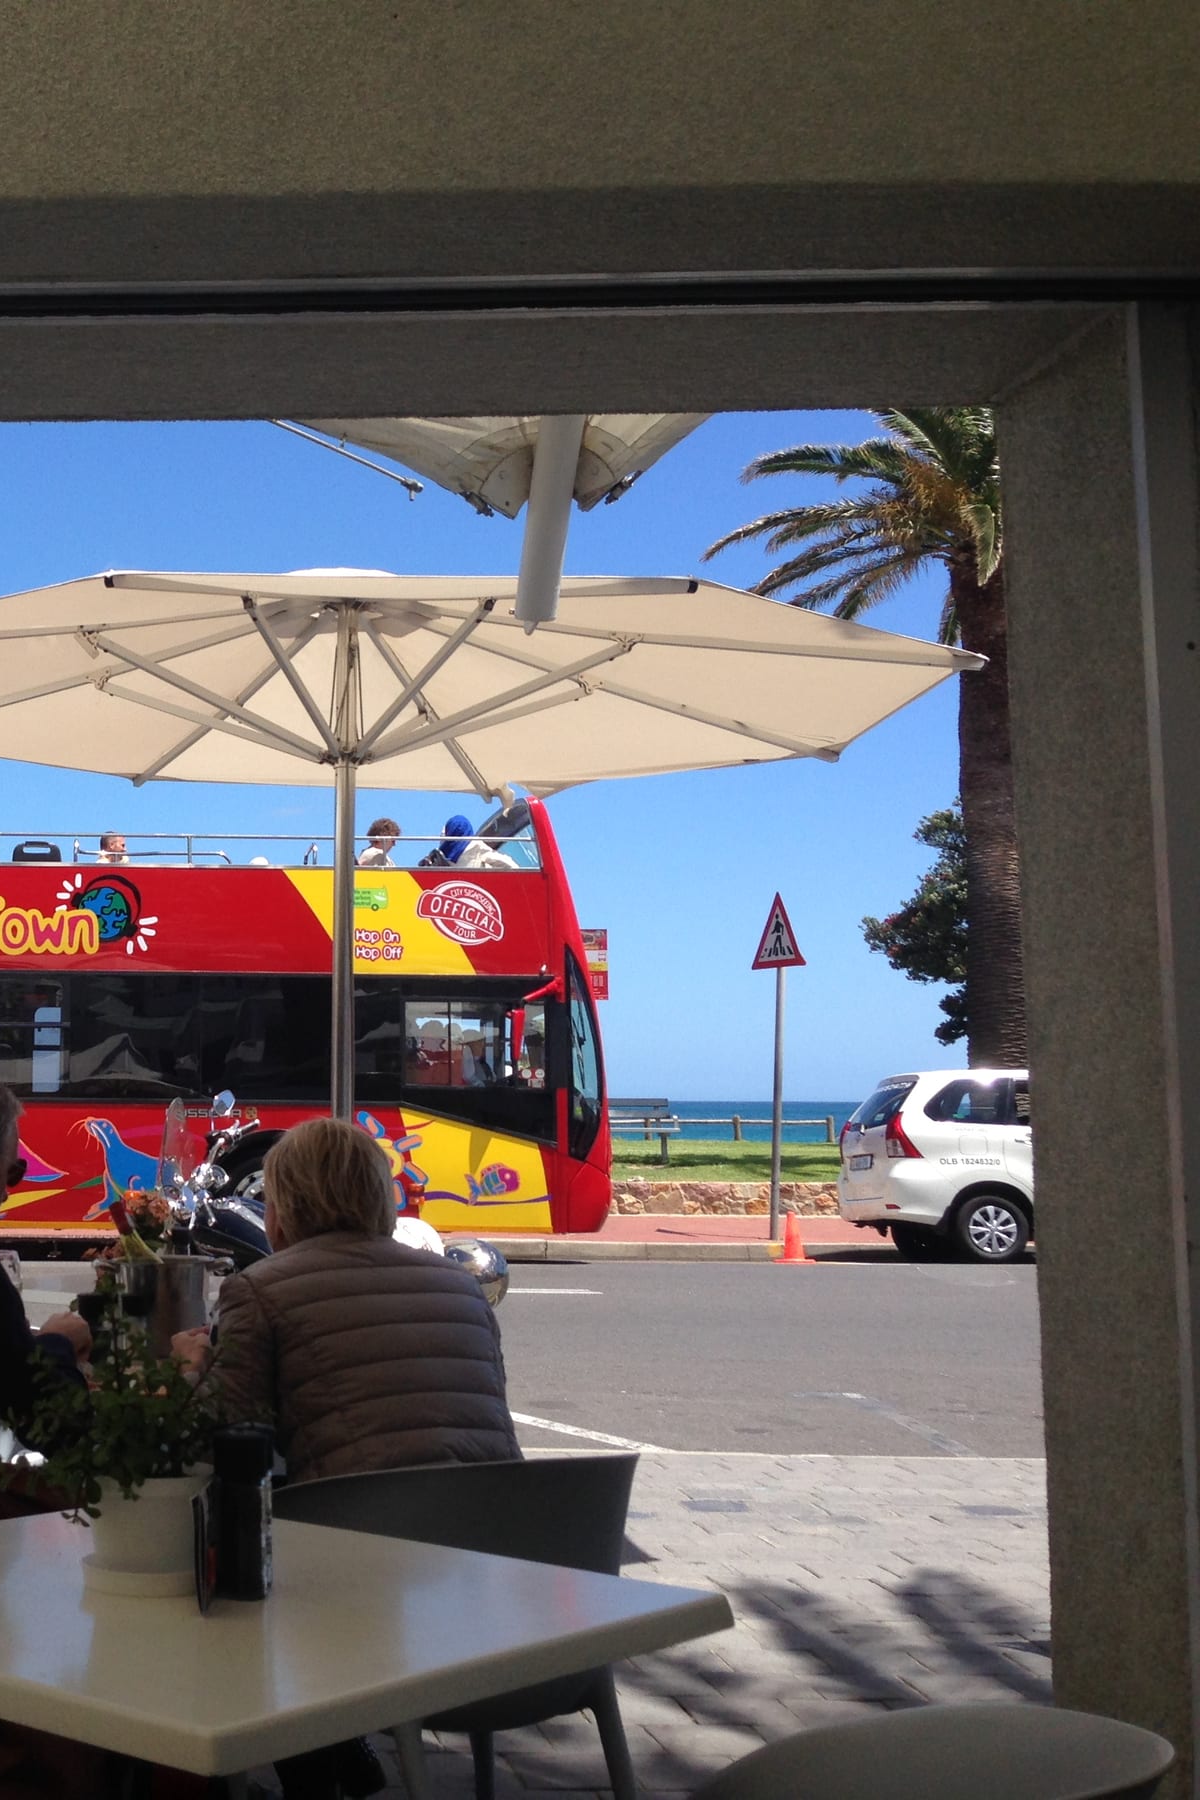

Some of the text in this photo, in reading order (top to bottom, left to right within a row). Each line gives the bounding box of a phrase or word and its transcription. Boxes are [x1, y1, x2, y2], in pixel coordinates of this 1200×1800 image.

[430, 896, 495, 933] OFFICIAL
[355, 928, 401, 945] Hop On
[453, 925, 476, 939] TOUR
[355, 945, 404, 962] Hop Off
